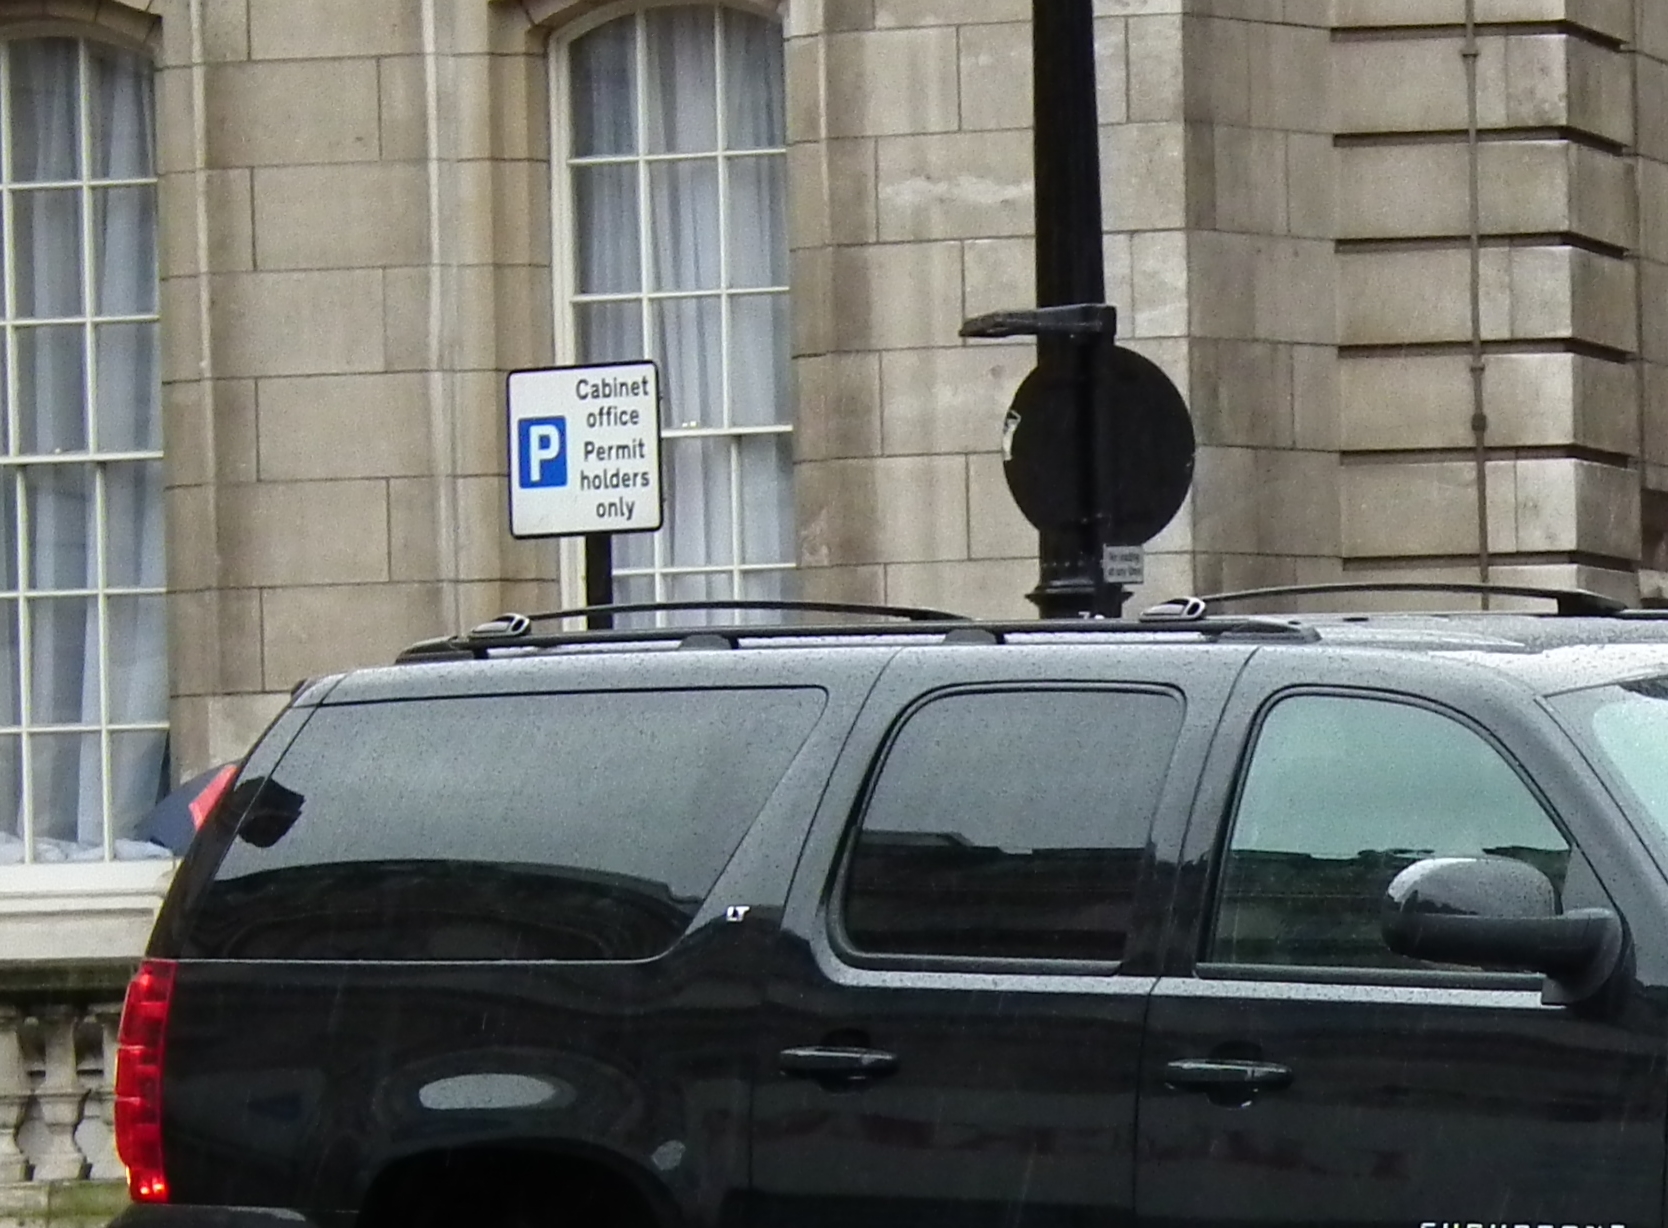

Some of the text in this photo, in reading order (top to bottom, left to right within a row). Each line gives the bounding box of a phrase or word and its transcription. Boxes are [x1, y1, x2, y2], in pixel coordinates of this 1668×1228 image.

[576, 376, 649, 400] Cabinet
[586, 405, 640, 428] office
[529, 423, 560, 483] P
[583, 438, 645, 462] Permit
[580, 468, 650, 491] holders
[596, 496, 636, 521] only
